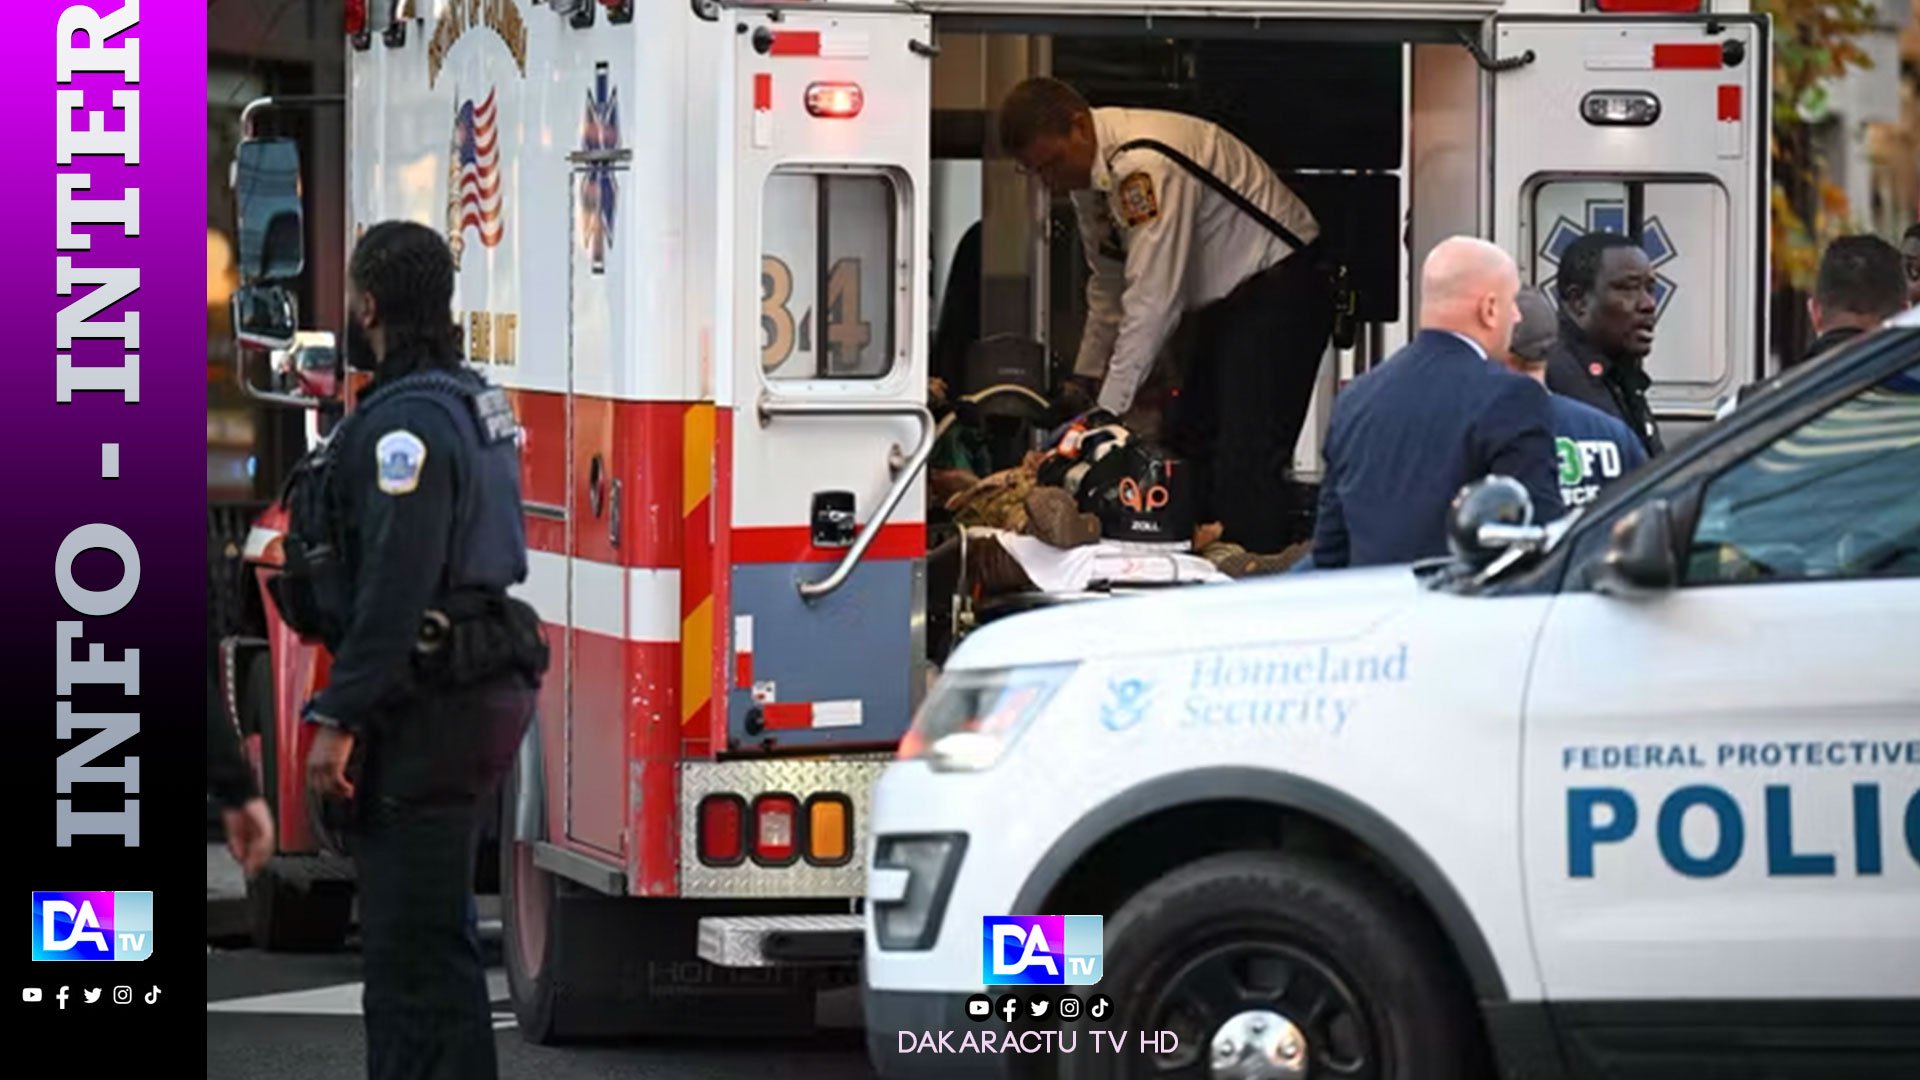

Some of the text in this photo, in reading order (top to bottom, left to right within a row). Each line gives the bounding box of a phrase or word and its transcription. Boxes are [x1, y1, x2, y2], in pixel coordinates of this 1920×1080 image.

[1131, 521, 1160, 531] ZOLL
[1189, 643, 1409, 690] Homeland
[1180, 694, 1353, 736] Security
[1562, 740, 1920, 770] FEDERAL PROTECTIVE
[1566, 782, 1920, 880] POLI
